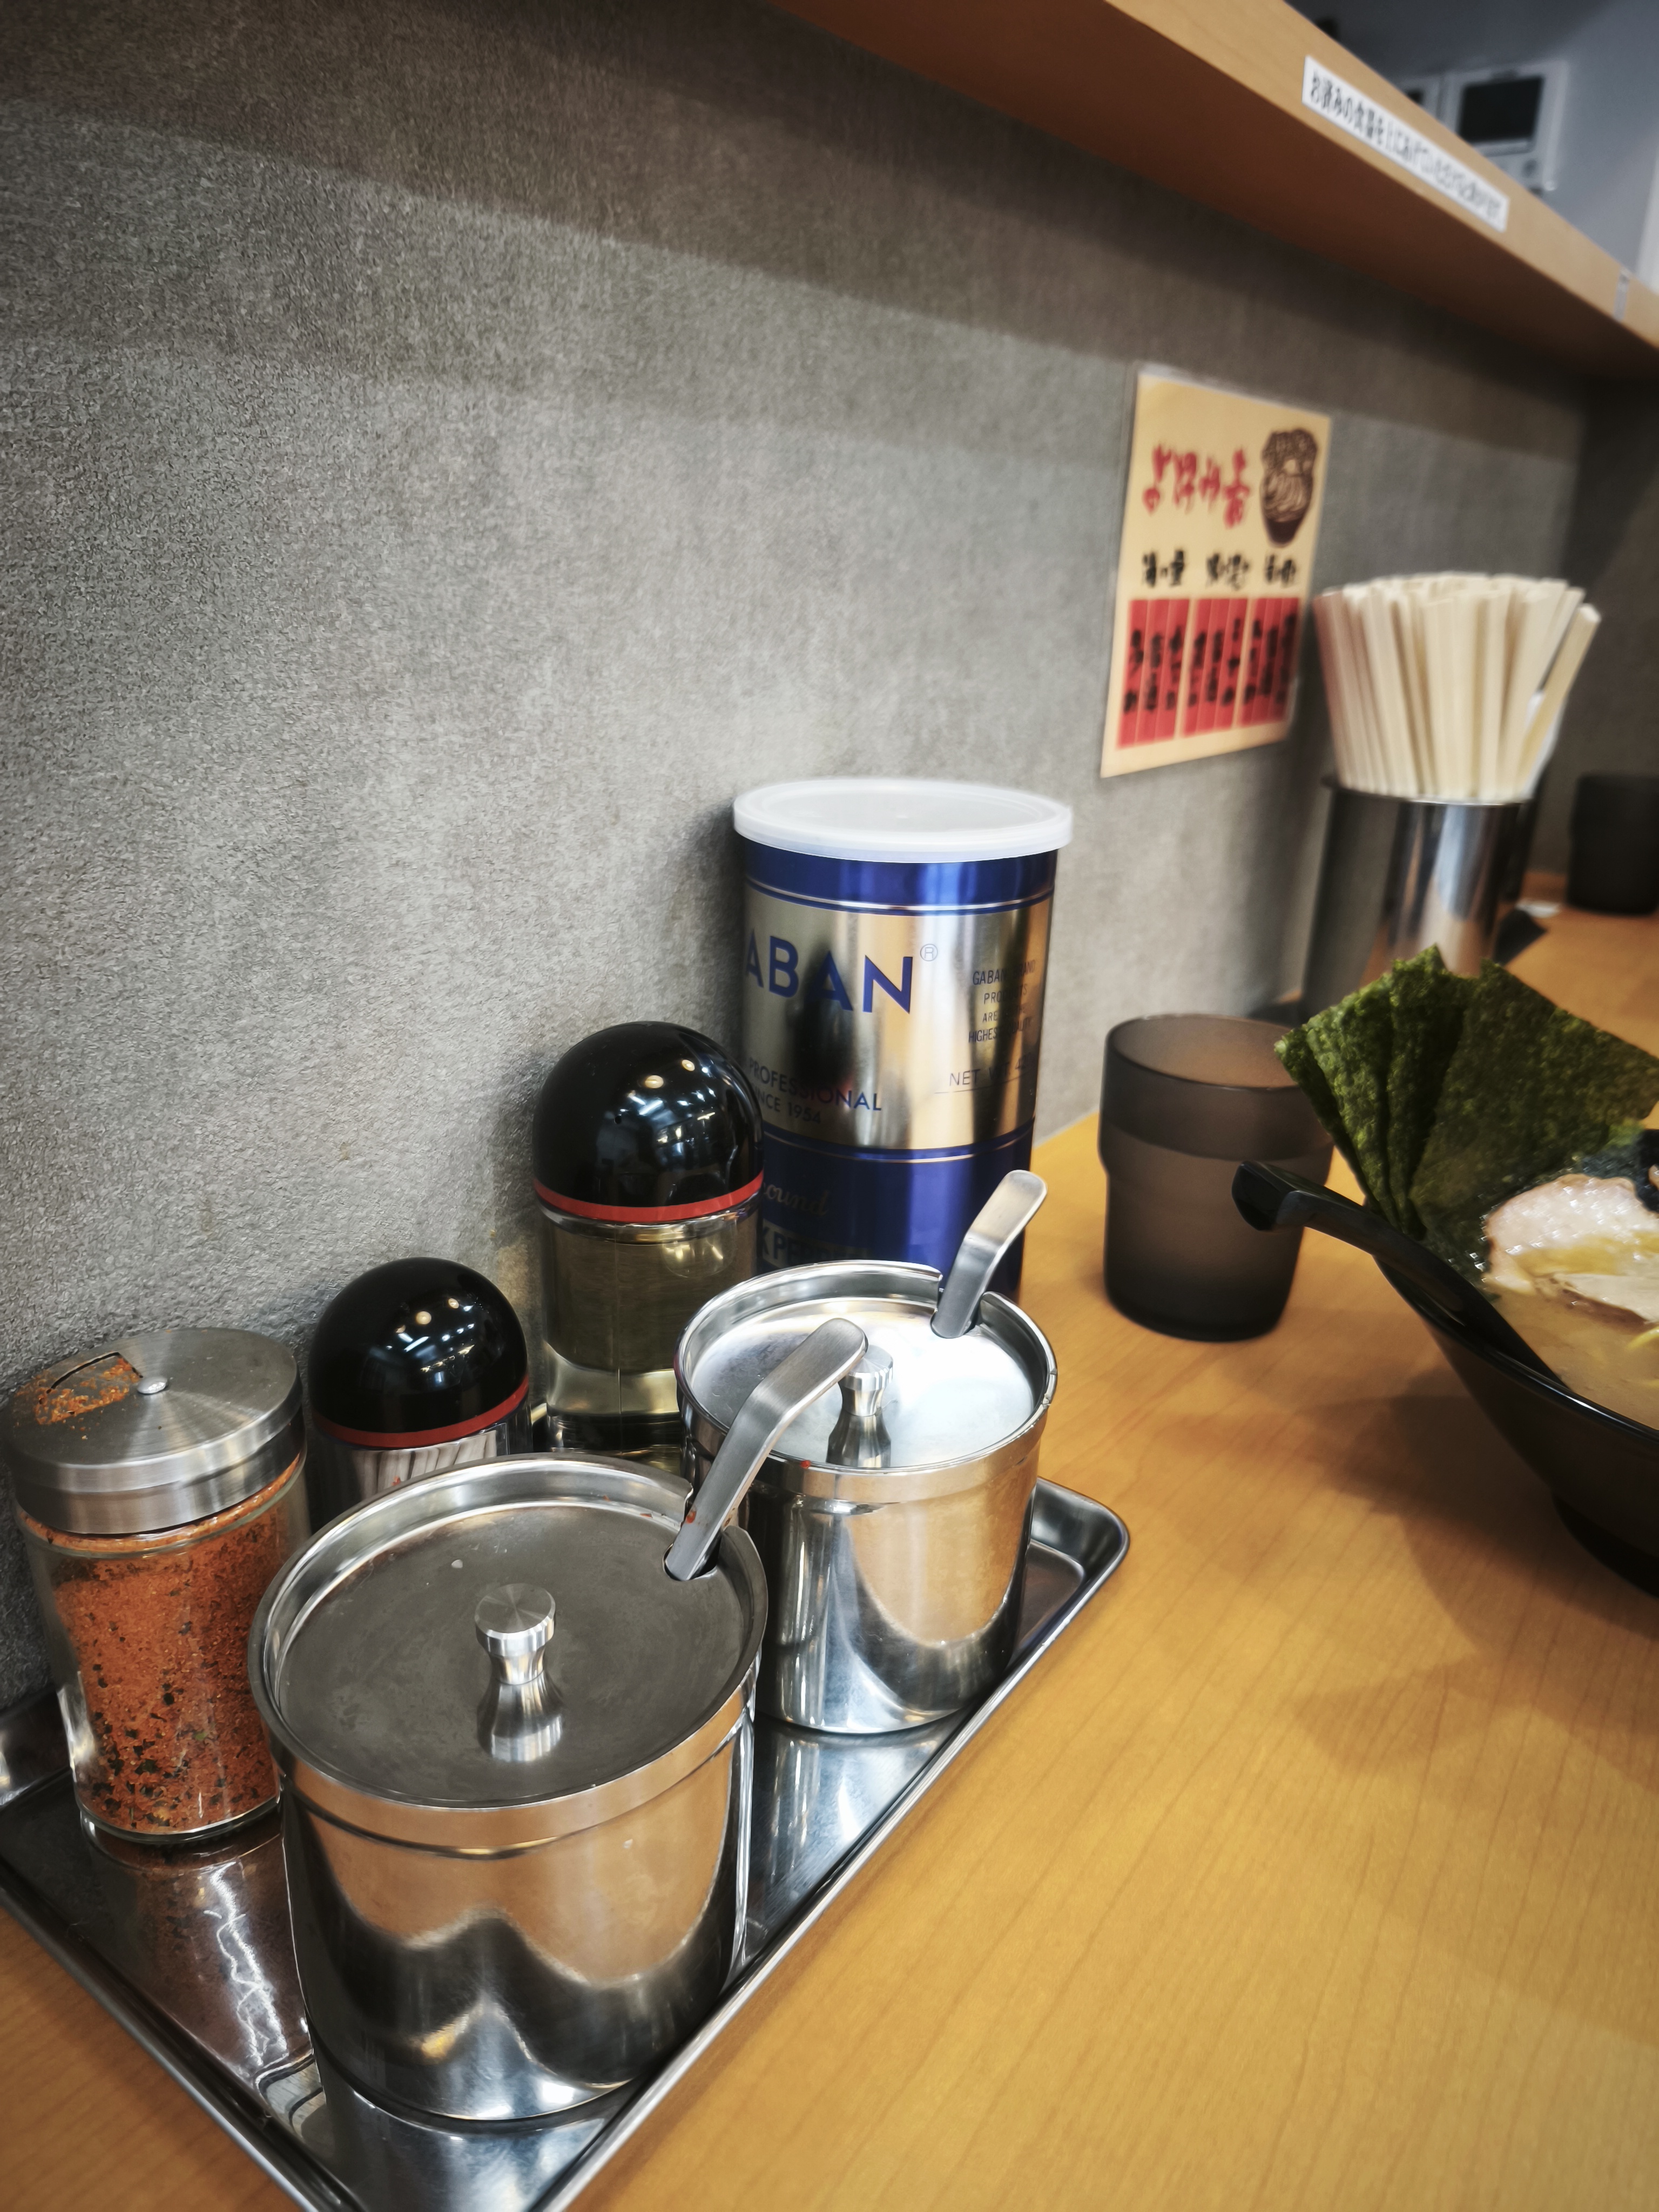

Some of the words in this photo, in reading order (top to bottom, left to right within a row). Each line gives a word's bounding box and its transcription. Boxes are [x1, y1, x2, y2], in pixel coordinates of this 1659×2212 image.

[746, 929, 913, 1014] ABAN
[973, 968, 1007, 986] GABAN
[982, 1010, 999, 1023] ARE
[749, 1056, 882, 1111] PROFESSIONAL
[949, 1069, 981, 1087] NET
[755, 1085, 781, 1112] INCE
[787, 1102, 821, 1124] 1954
[763, 1182, 830, 1217] ound
